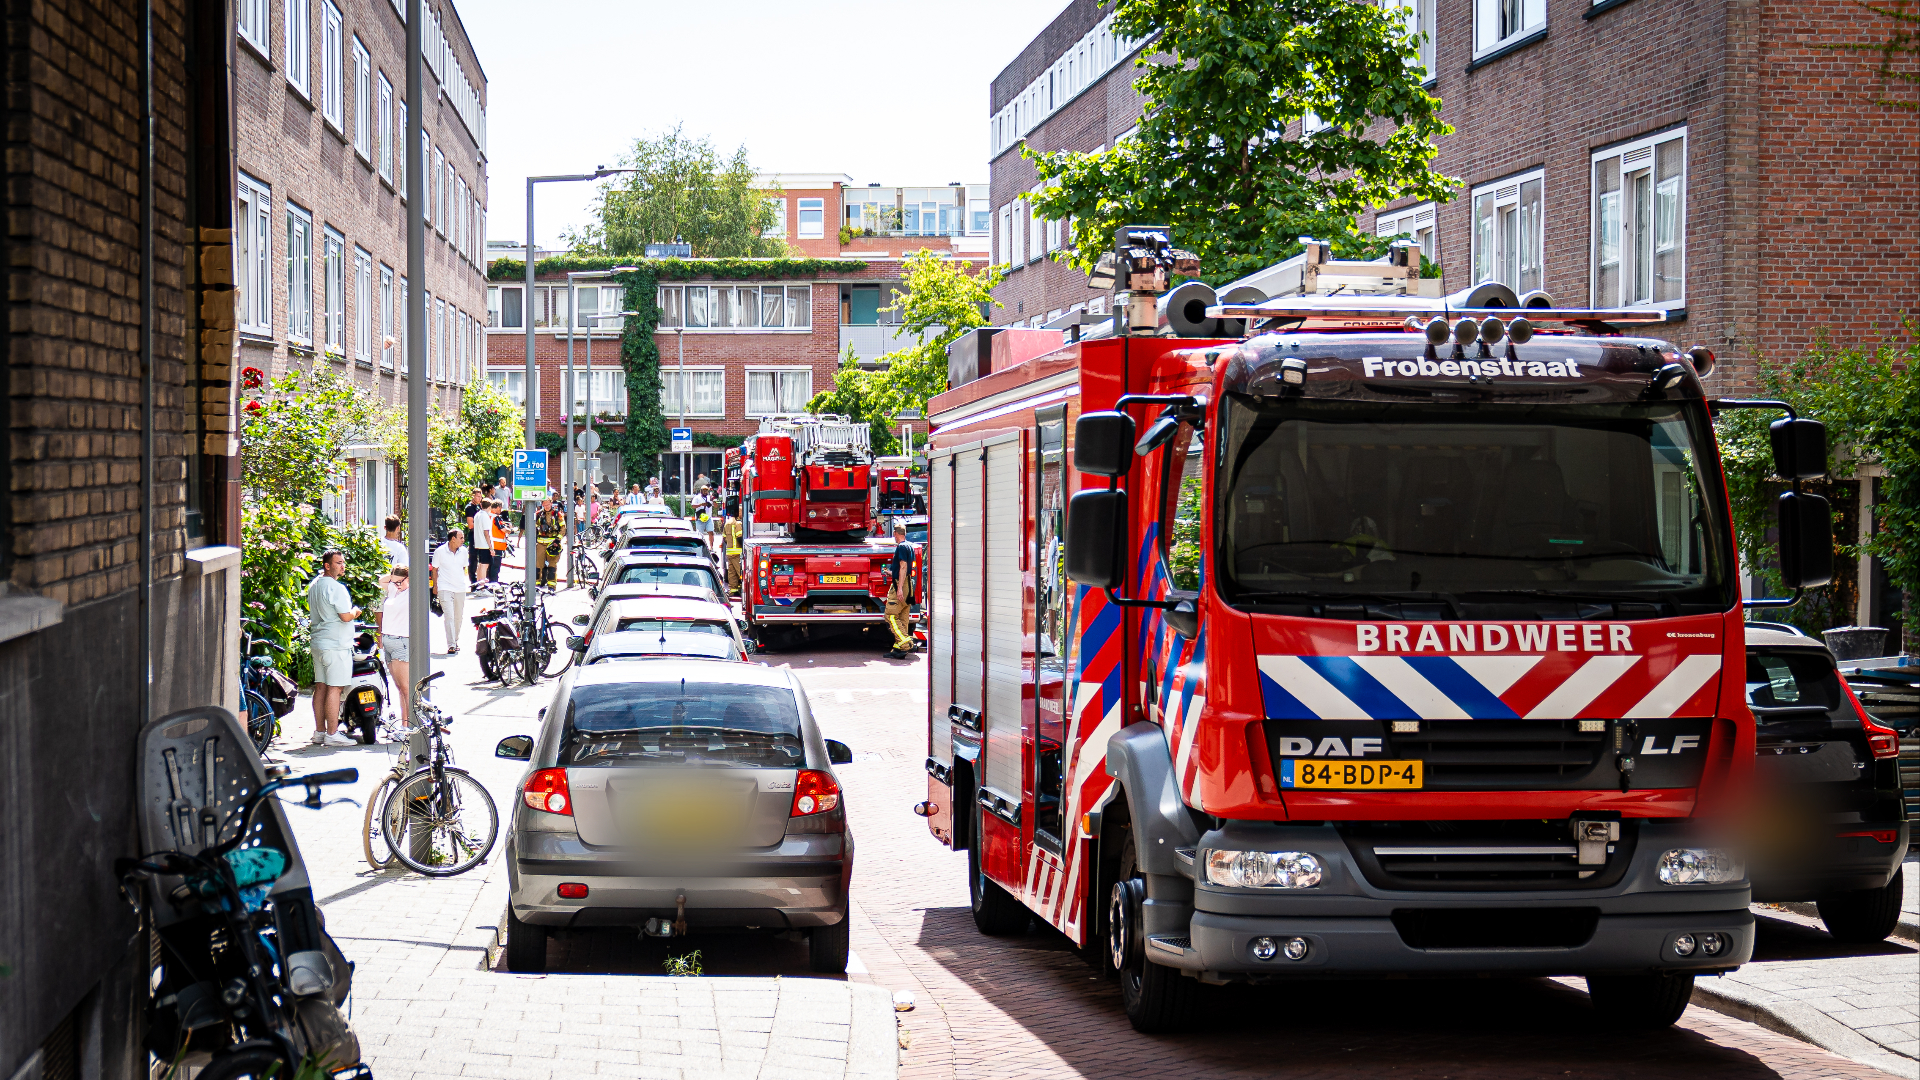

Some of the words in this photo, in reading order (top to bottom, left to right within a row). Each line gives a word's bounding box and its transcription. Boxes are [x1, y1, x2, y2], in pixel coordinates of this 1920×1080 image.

[1362, 356, 1582, 378] Frobenstraat
[516, 452, 528, 468] P
[1356, 624, 1634, 653] BRANDWEER
[1279, 737, 1383, 757] DAF
[1640, 735, 1701, 755] LF
[1282, 775, 1293, 783] NL
[1301, 763, 1416, 785] 84-BDP-4
